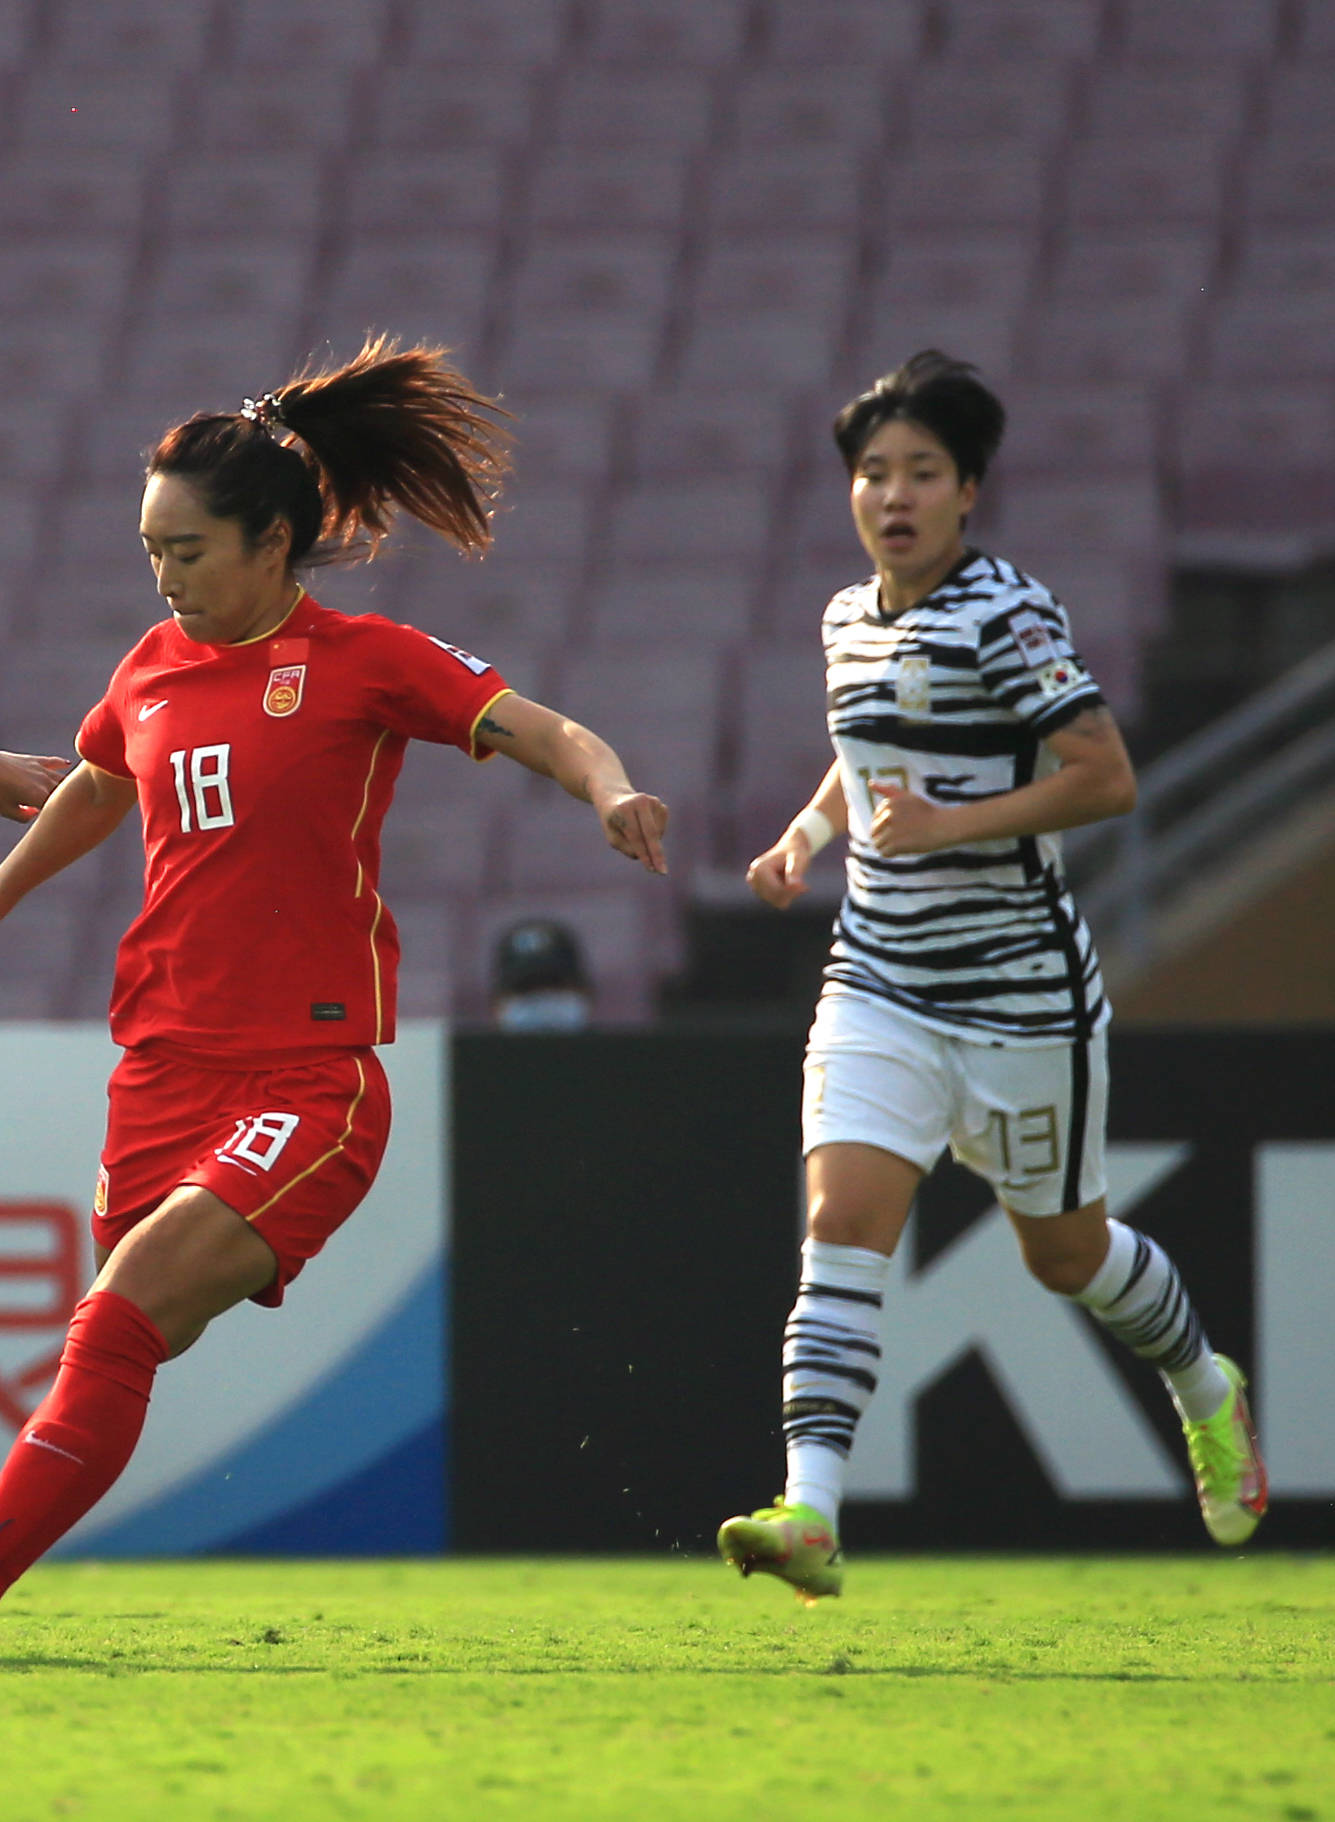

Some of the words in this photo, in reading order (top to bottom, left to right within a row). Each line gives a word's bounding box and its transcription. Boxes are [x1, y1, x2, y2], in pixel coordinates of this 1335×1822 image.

[169, 742, 236, 833] 18
[214, 1111, 301, 1172] 18
[987, 1104, 1059, 1174] 13
